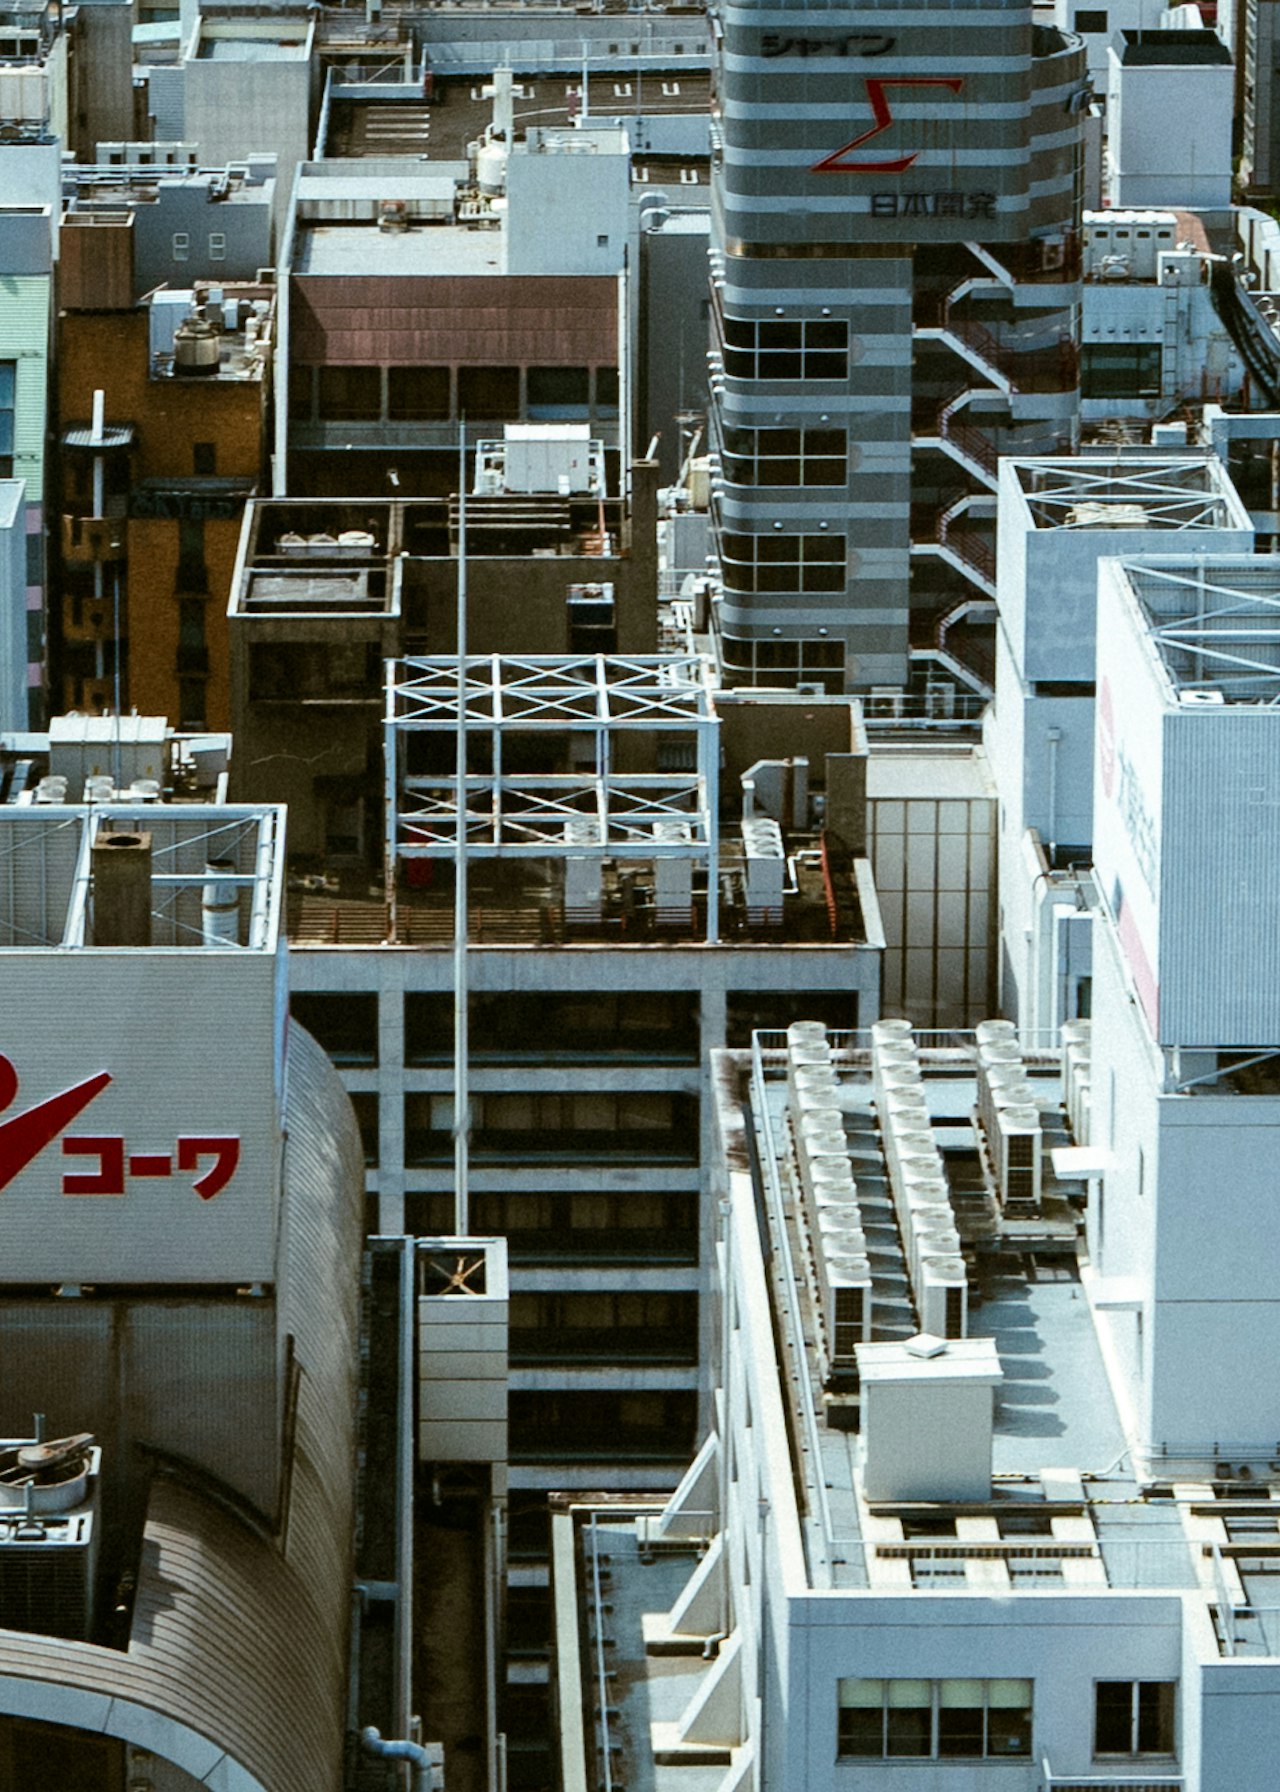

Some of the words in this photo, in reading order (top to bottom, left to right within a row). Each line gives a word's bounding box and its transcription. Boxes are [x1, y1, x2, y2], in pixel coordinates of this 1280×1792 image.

[761, 34, 897, 57] シャイン
[870, 191, 998, 220] 日本開発
